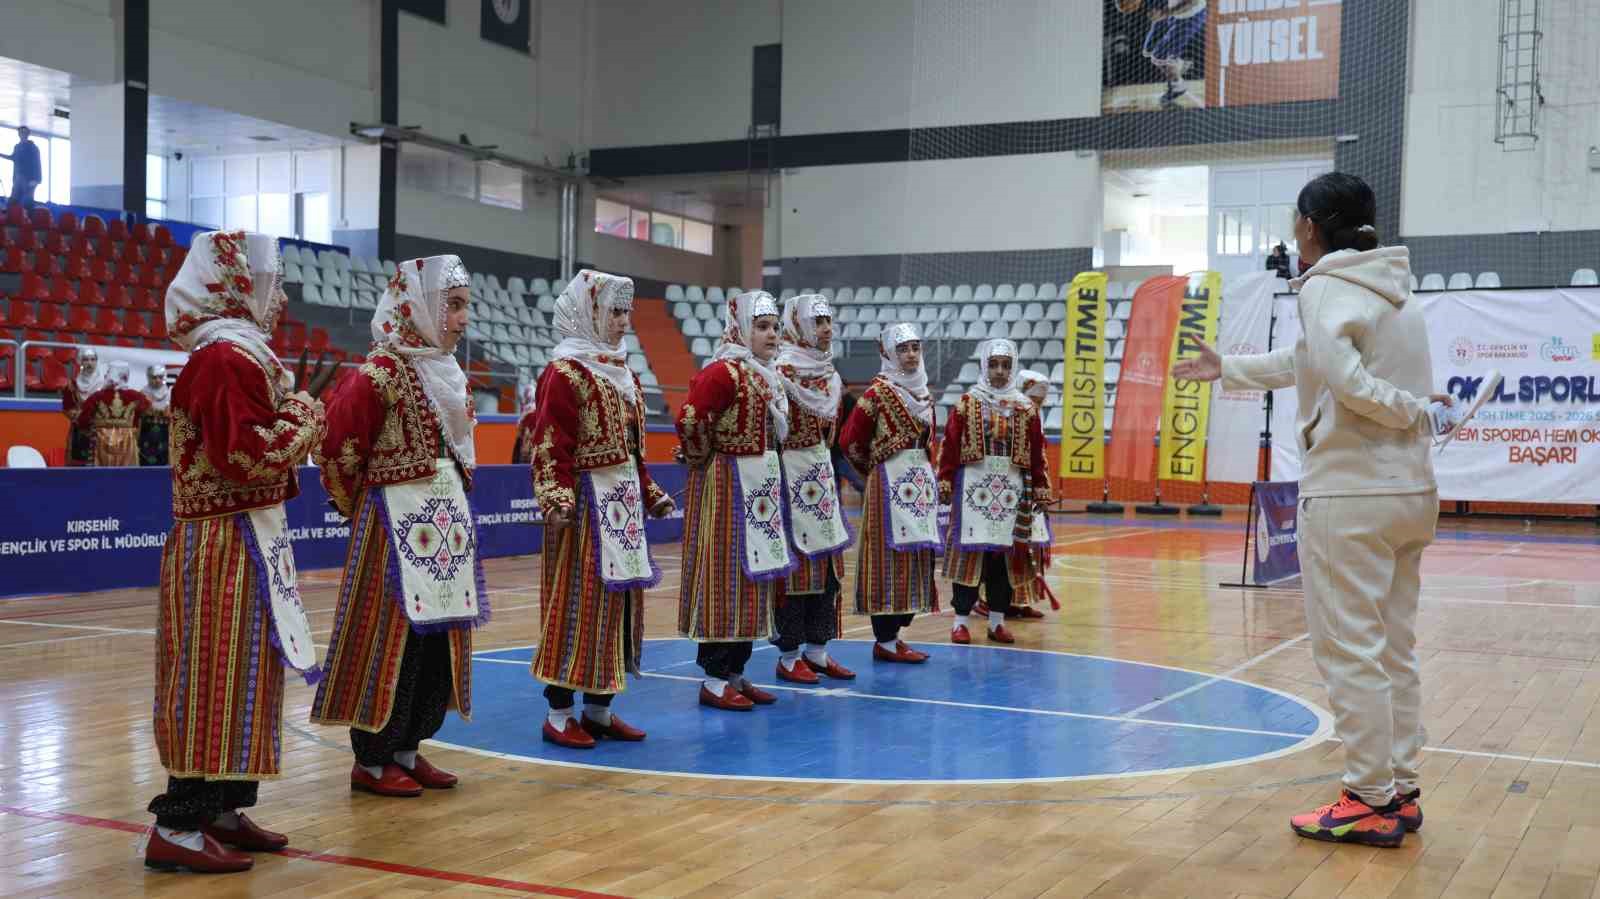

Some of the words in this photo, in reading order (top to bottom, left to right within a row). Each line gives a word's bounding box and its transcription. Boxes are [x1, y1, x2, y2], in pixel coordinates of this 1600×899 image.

[1171, 287, 1210, 476] ENGLISTIME
[1447, 375, 1516, 403] OKL
[1482, 428, 1541, 442] SPORDA
[1545, 428, 1577, 443] HEM
[1508, 445, 1577, 466] BAŞARI
[66, 517, 120, 533] KIRŞEHİR
[311, 527, 324, 539] VE
[325, 527, 350, 539] SPOR
[0, 537, 47, 555] ENÇLİK
[50, 540, 65, 552] VE
[67, 538, 99, 551] SPOR
[101, 535, 112, 549] İL
